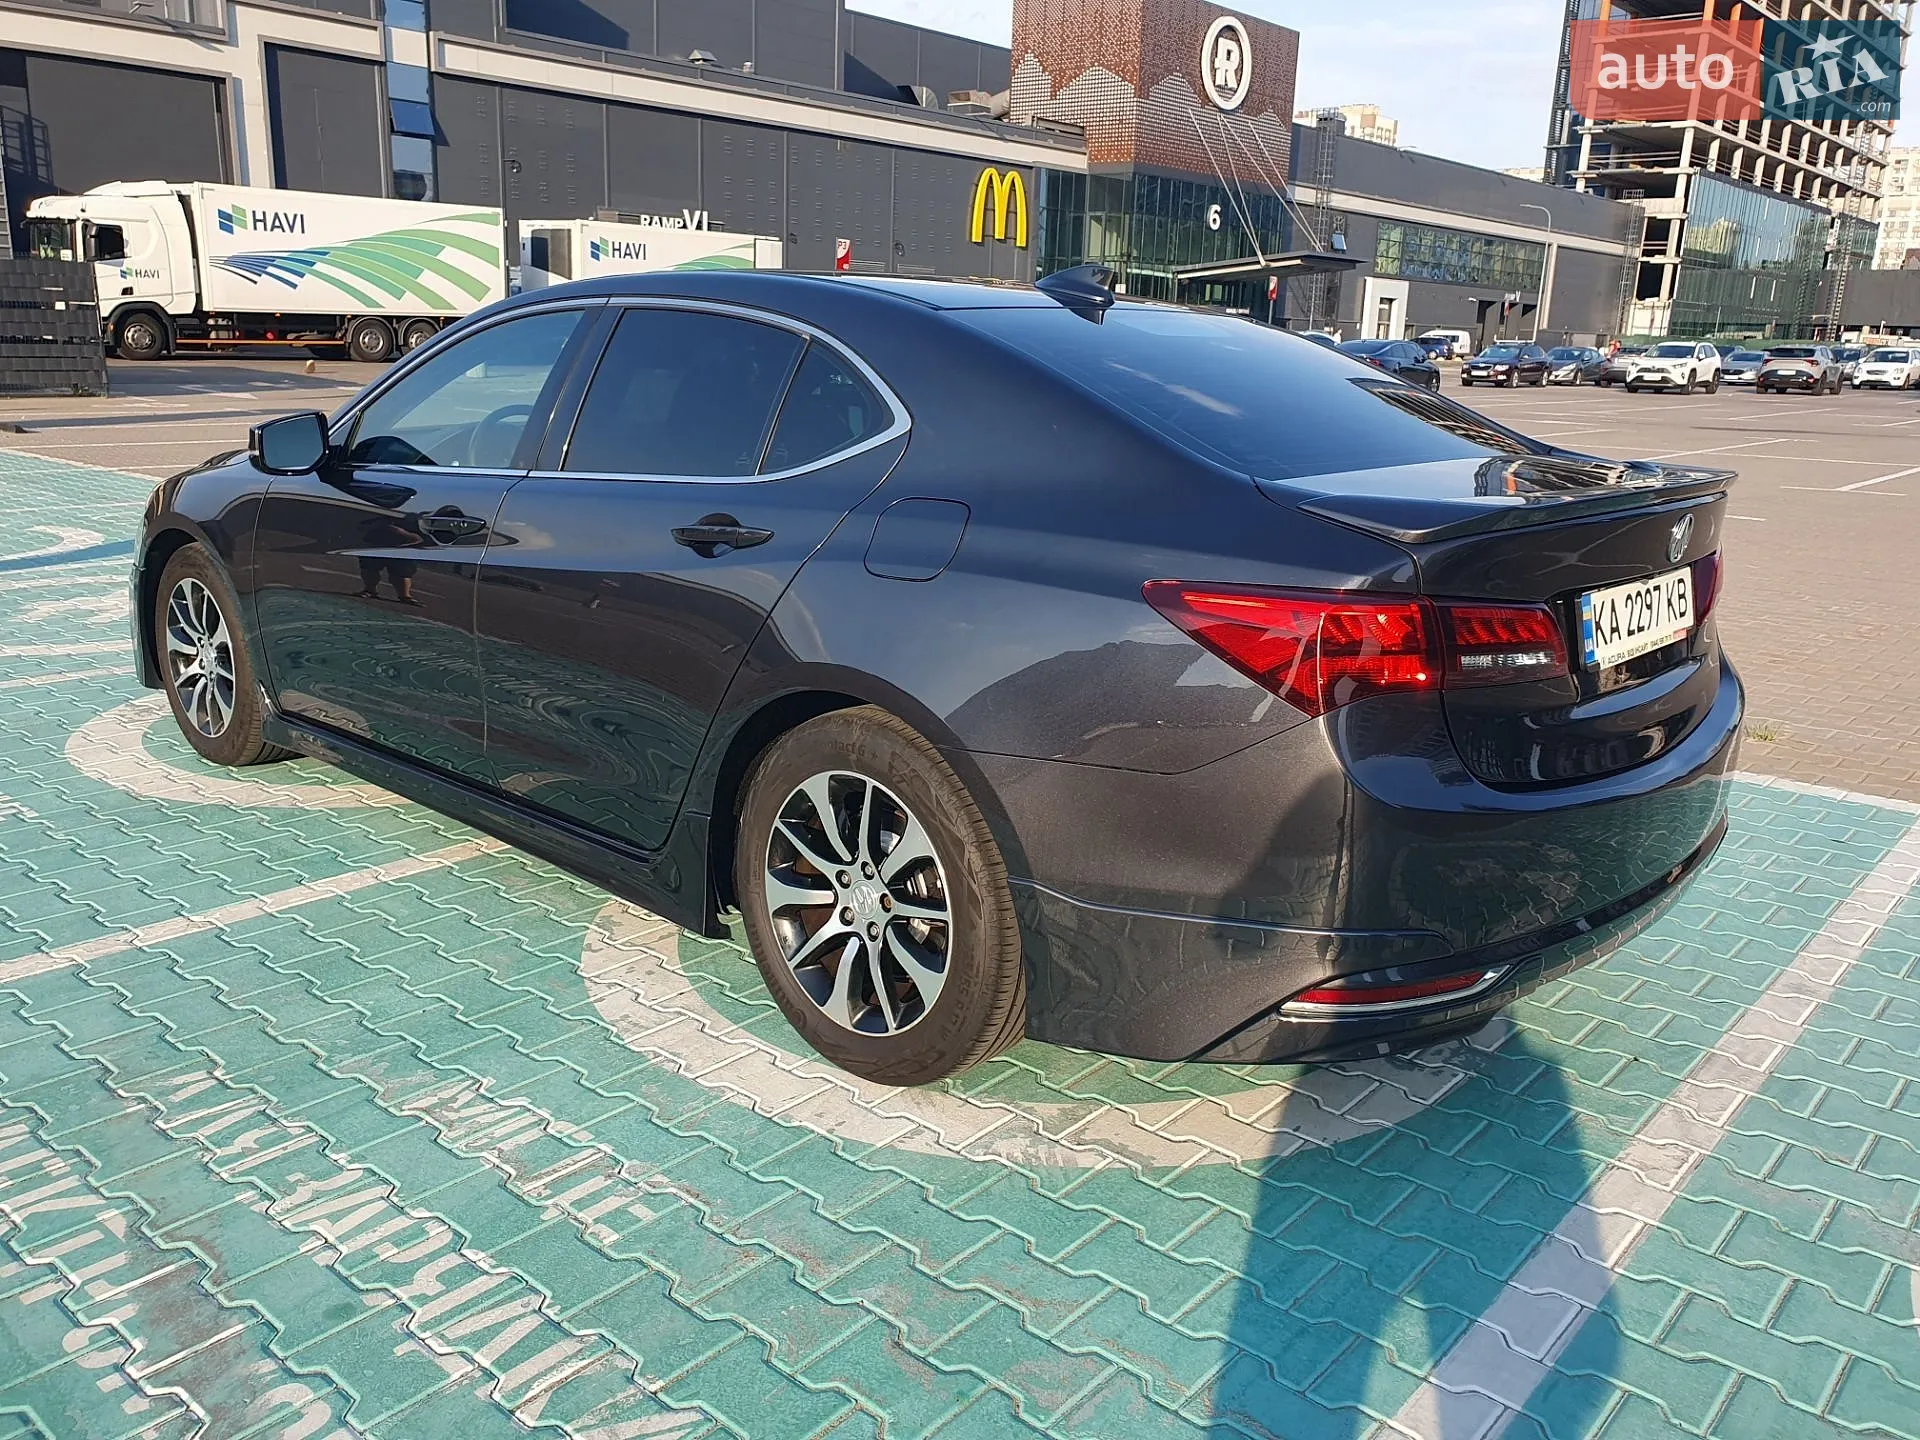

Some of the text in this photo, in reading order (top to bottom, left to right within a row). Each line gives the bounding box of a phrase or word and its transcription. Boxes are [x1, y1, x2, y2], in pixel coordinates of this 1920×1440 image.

[1214, 37, 1240, 91] R
[970, 167, 1027, 248] M
[1207, 204, 1221, 231] 6
[252, 210, 306, 234] HAVI
[640, 214, 684, 229] RAMP
[611, 241, 647, 261] HAVI
[134, 268, 160, 279] HAVI
[1593, 577, 1688, 648] KA 2297 KB
